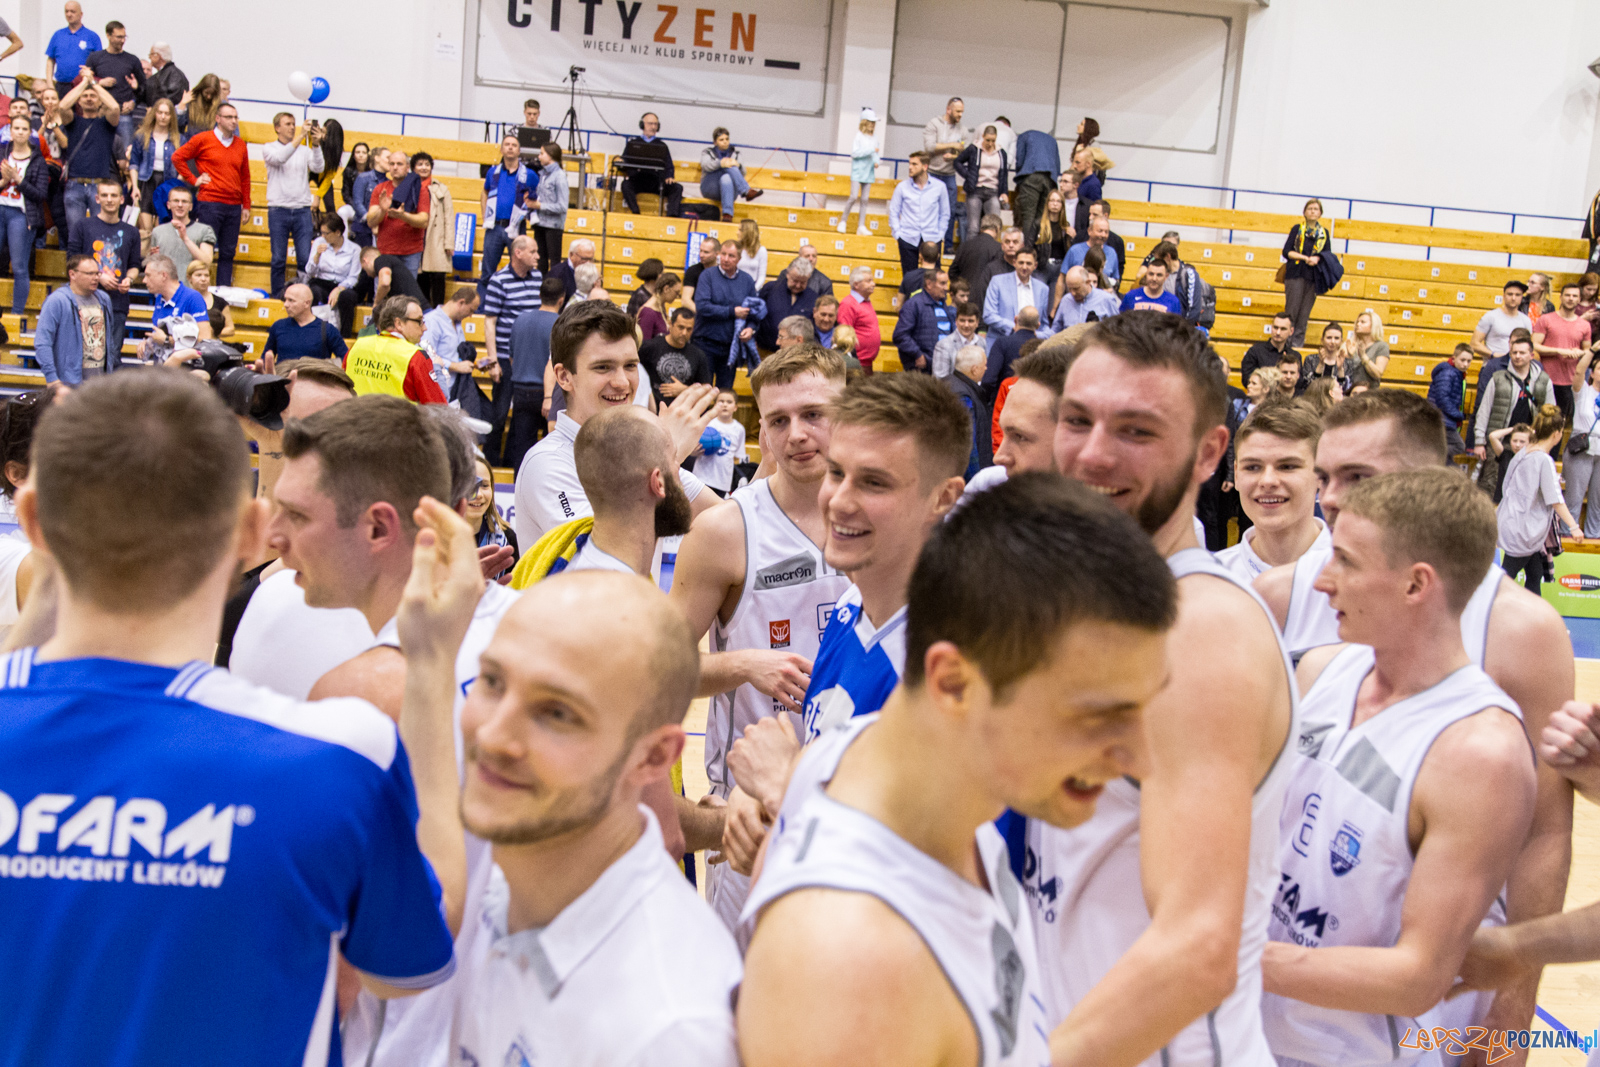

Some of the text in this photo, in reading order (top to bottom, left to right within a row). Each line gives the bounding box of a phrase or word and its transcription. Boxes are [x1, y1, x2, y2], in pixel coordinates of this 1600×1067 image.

[507, 0, 757, 52] CITYZEN
[583, 39, 755, 66] WIĘCEJ NIŻ KLUB SPORTOWY
[353, 367, 391, 381] SECURITY
[354, 357, 392, 373] JOKER
[558, 491, 576, 518] Joma
[763, 566, 812, 584] macron
[132, 860, 227, 888] LEKÓW
